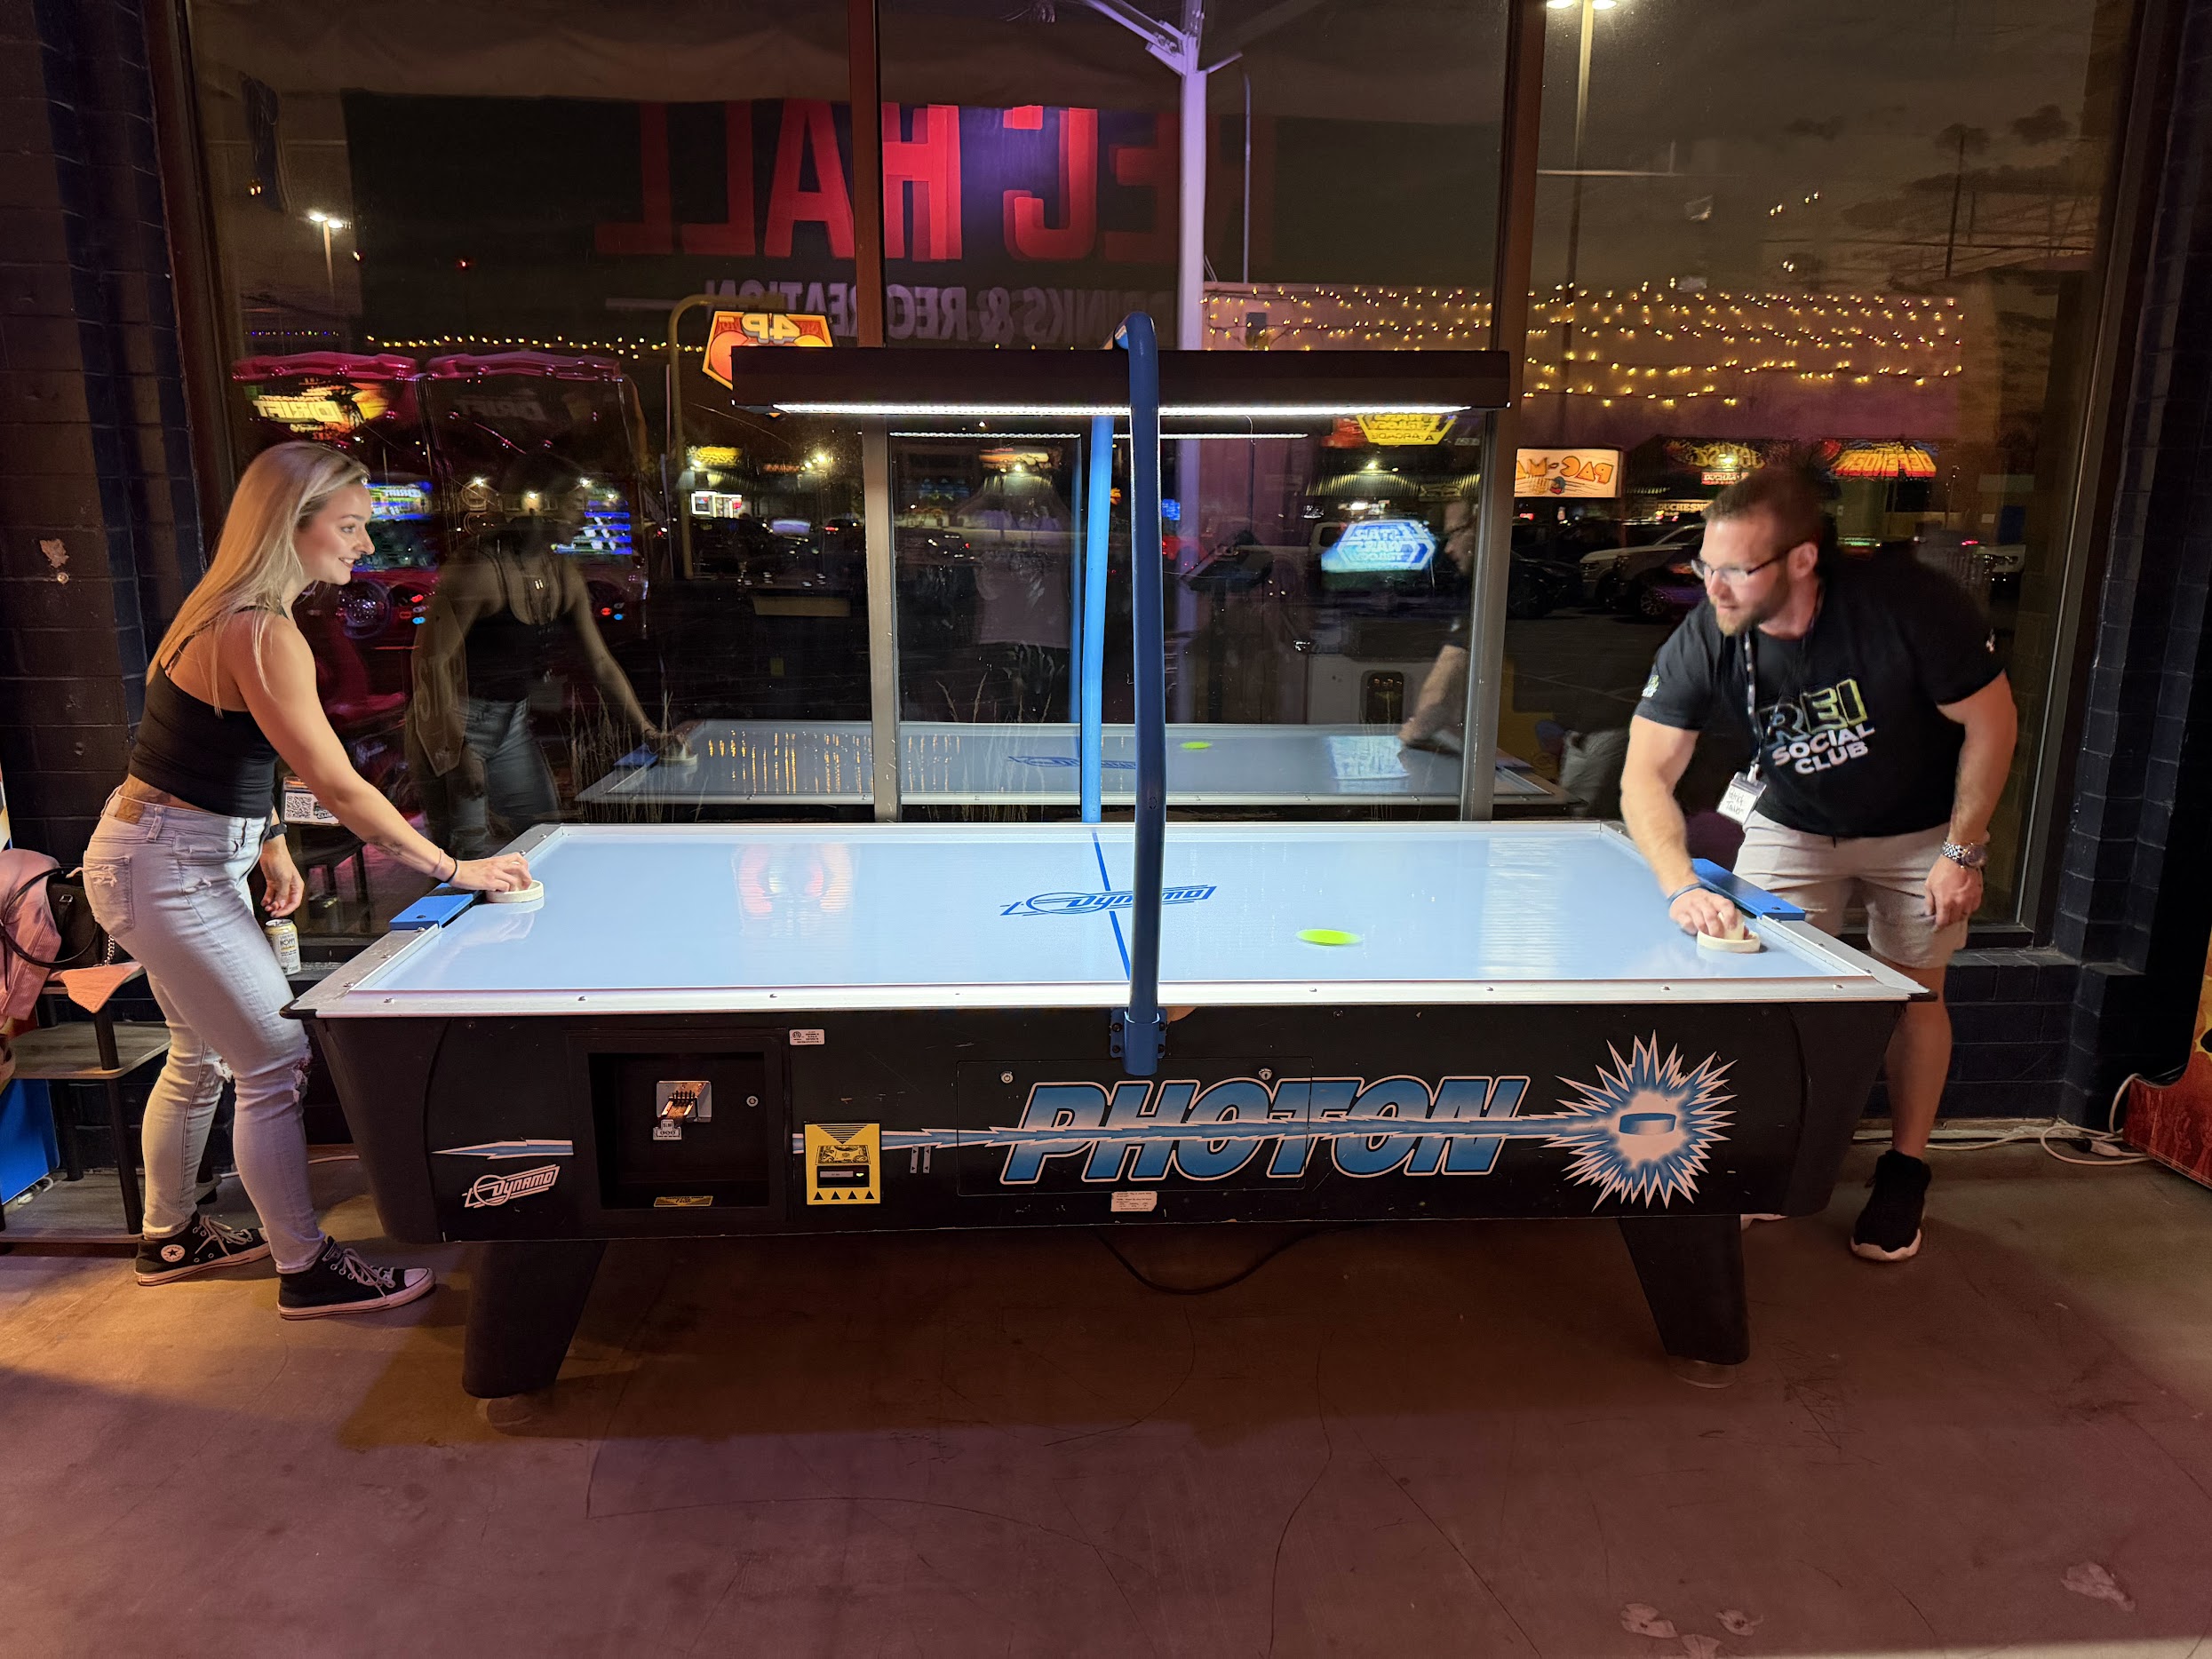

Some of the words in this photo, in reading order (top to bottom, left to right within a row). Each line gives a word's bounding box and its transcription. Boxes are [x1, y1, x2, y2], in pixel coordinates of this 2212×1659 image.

[1771, 723, 1875, 766] SOCIAL
[1794, 741, 1868, 775] CLUB
[1048, 885, 1208, 913] Dynmo
[1000, 1074, 1531, 1185] PHOTON
